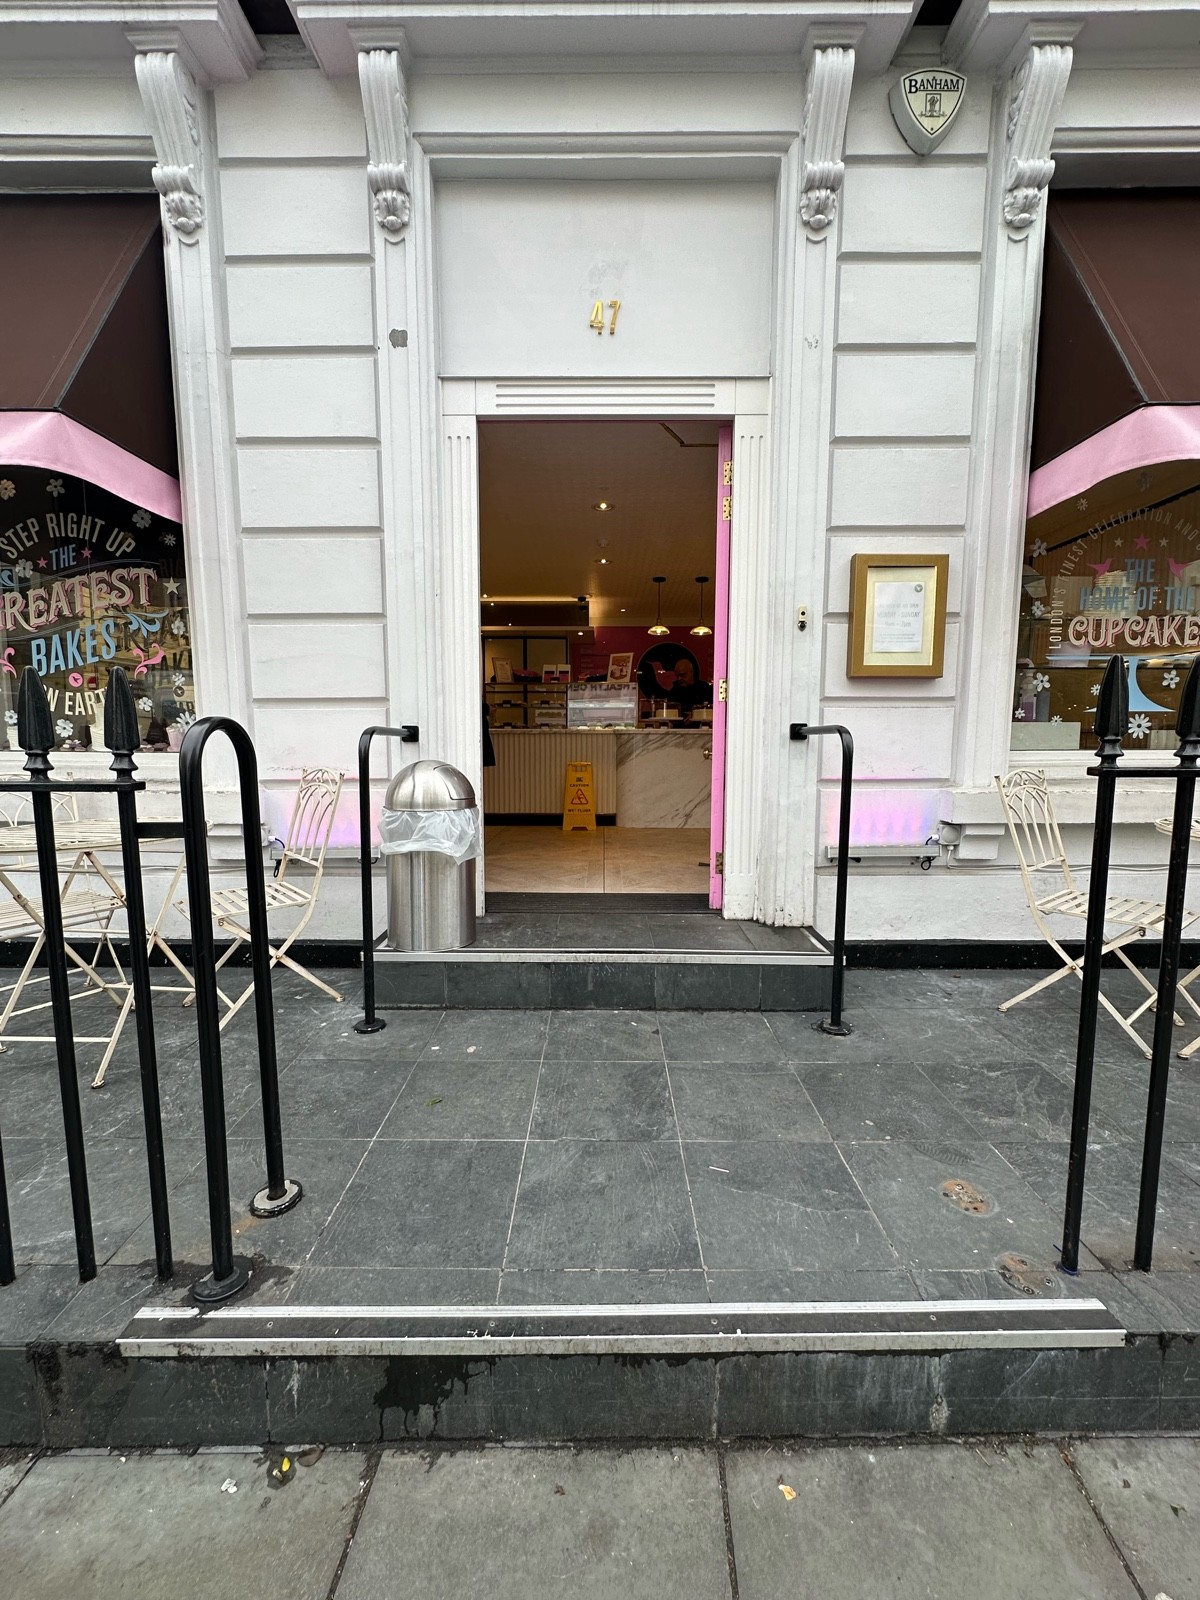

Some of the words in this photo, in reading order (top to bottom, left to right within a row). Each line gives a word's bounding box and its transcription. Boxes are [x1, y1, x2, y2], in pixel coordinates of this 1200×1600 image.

[908, 78, 960, 94] BANHAM
[589, 299, 621, 335] 47
[0, 517, 41, 559] STEP
[45, 512, 105, 543] RIGHT
[105, 527, 136, 557] UP
[49, 544, 77, 571] THE
[1125, 558, 1156, 583] THE
[1048, 586, 1066, 649] LONDON'S
[1057, 538, 1089, 582] FINEST
[1088, 508, 1173, 540] CELEBRATION
[1174, 518, 1199, 541] AND
[0, 566, 158, 632] REATEST
[1079, 586, 1130, 611] HOME
[1136, 586, 1158, 611] OF
[1164, 586, 1196, 611] THE
[31, 619, 117, 678] BAKES
[1068, 615, 1200, 648] CUPCAKE
